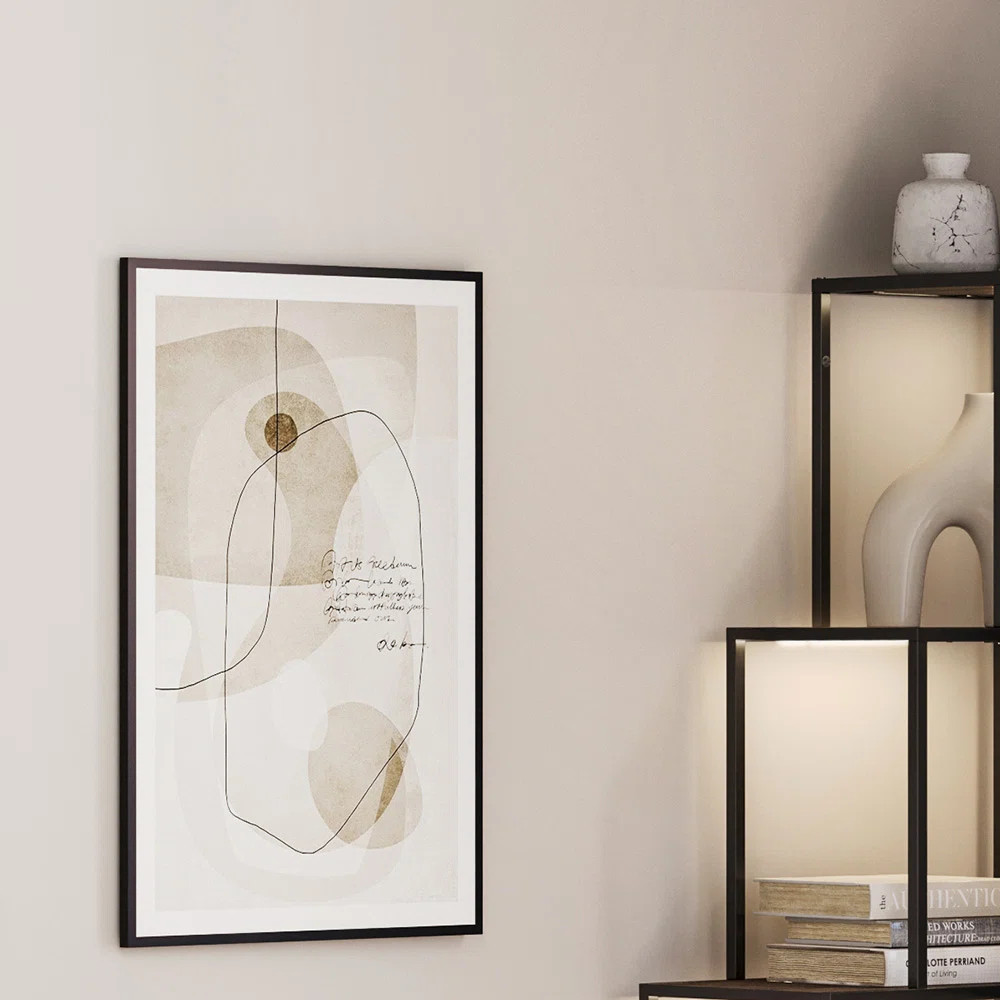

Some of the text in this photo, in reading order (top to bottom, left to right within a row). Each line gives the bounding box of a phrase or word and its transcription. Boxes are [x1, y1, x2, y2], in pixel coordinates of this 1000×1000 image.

[942, 921, 975, 931] WORKS
[949, 957, 986, 966] PERRIAND
[940, 970, 957, 978] Living
